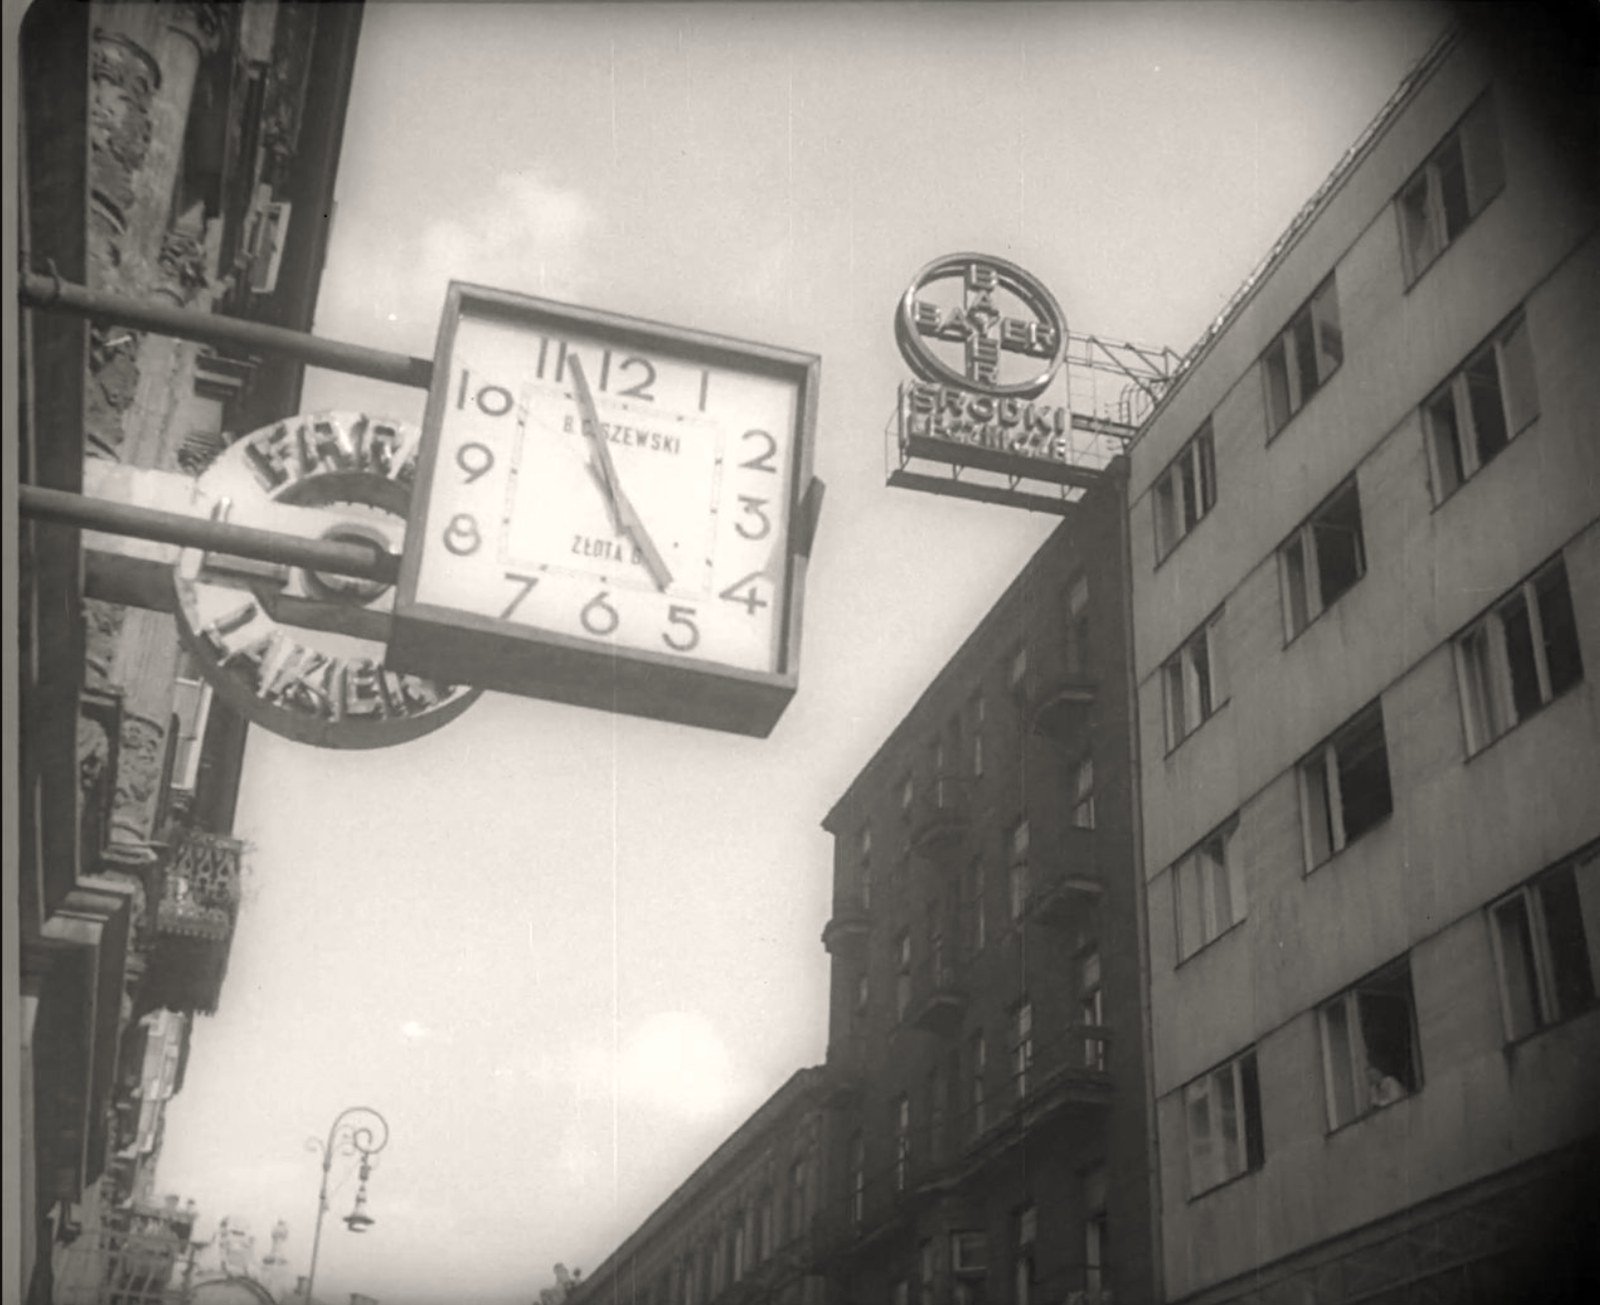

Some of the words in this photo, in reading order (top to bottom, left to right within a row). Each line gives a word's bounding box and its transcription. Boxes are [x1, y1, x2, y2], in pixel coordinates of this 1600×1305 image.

[915, 301, 1057, 357] BAYER
[536, 338, 568, 383] 11
[599, 350, 657, 402] 12
[456, 369, 515, 418] 10
[698, 369, 710, 412] 1
[456, 442, 495, 485] 9
[738, 430, 778, 473] 2
[442, 513, 483, 558] 8
[733, 494, 772, 542] 3
[571, 535, 622, 563] ZŁOTA
[500, 573, 540, 620] 7
[580, 591, 620, 637] 6
[718, 571, 769, 616] 4
[661, 605, 701, 652] 5
